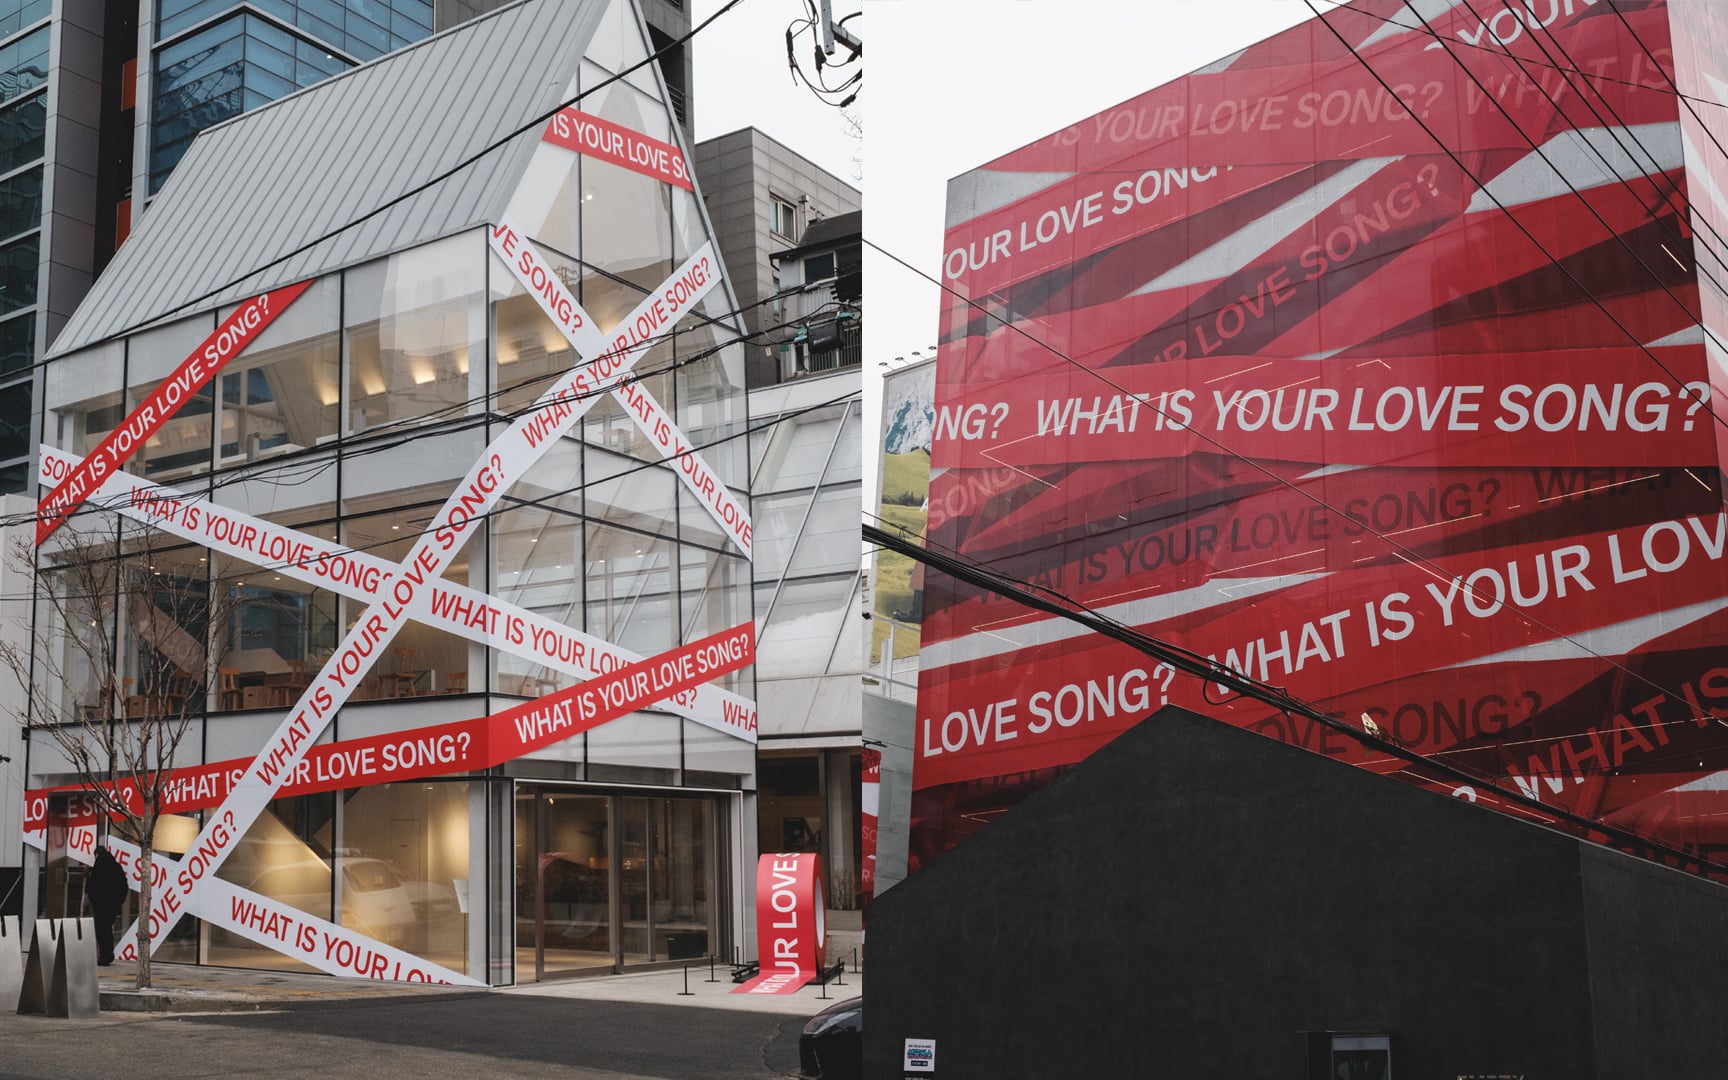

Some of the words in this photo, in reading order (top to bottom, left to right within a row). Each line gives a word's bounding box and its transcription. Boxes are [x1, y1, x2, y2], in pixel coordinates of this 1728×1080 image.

[573, 118, 625, 158] YOUR
[627, 138, 670, 175] LOVE
[1093, 103, 1185, 144] YOUR
[1190, 95, 1288, 137] LOVE
[1292, 80, 1444, 129] SONG?
[1465, 55, 1618, 116] WHAT
[942, 228, 1012, 280] OUR
[1019, 191, 1104, 252] LOVE
[1111, 165, 1233, 214] SONG
[1194, 265, 1297, 356] LOVE
[1300, 162, 1440, 282] SONG?
[40, 471, 86, 527] WHAT
[88, 454, 107, 482] IS
[106, 406, 157, 461] YOUR
[156, 360, 205, 414] LOVE
[204, 293, 271, 369] SONG?
[518, 250, 583, 335] SONG?
[653, 416, 670, 447] IS
[674, 438, 722, 508] YOUR
[713, 500, 752, 549] LOVE
[1037, 392, 1149, 437] WHAT
[1155, 389, 1196, 431] IS
[1212, 387, 1339, 432] YOUR
[1348, 384, 1485, 432] LOVE
[1493, 381, 1711, 433] SONG?
[131, 485, 181, 523] WHAT
[181, 505, 200, 531] IS
[205, 511, 258, 551] YOUR
[258, 531, 314, 571] LOVE
[430, 588, 501, 636] WHAT
[505, 614, 525, 646] IS
[530, 623, 585, 668] YOUR
[178, 810, 238, 895] SONG?
[255, 709, 313, 787] WHAT
[314, 686, 333, 719] IS
[327, 614, 389, 689] YOUR
[382, 545, 441, 621] LOVE
[434, 453, 506, 551] SONG?
[521, 389, 572, 449] WHAT
[570, 374, 591, 404] IS
[587, 335, 632, 386] YOUR
[628, 301, 669, 348] LOVE
[665, 256, 712, 313] SONG?
[1078, 550, 1108, 585] IS
[1118, 523, 1220, 575] YOUR
[1231, 499, 1330, 553] LOVE
[1343, 477, 1502, 540] SONG?
[922, 698, 1018, 758] LOVE
[1027, 661, 1177, 734] SONG?
[1207, 609, 1351, 696] WHAT
[1365, 592, 1415, 648] IS
[1425, 543, 1597, 627] YOUR
[163, 772, 221, 805] WHAT
[316, 747, 376, 782] LOVE
[382, 731, 471, 770] SONG?
[514, 698, 573, 744] WHAT
[578, 691, 597, 721] IS
[598, 670, 651, 712] YOUR
[650, 653, 696, 692] LOVE
[696, 632, 750, 674] SONG?
[1506, 694, 1670, 801] WHAT
[231, 895, 293, 943] WHAT
[295, 922, 318, 953] IS
[323, 933, 389, 981] YOUR
[771, 860, 799, 929] LOVE
